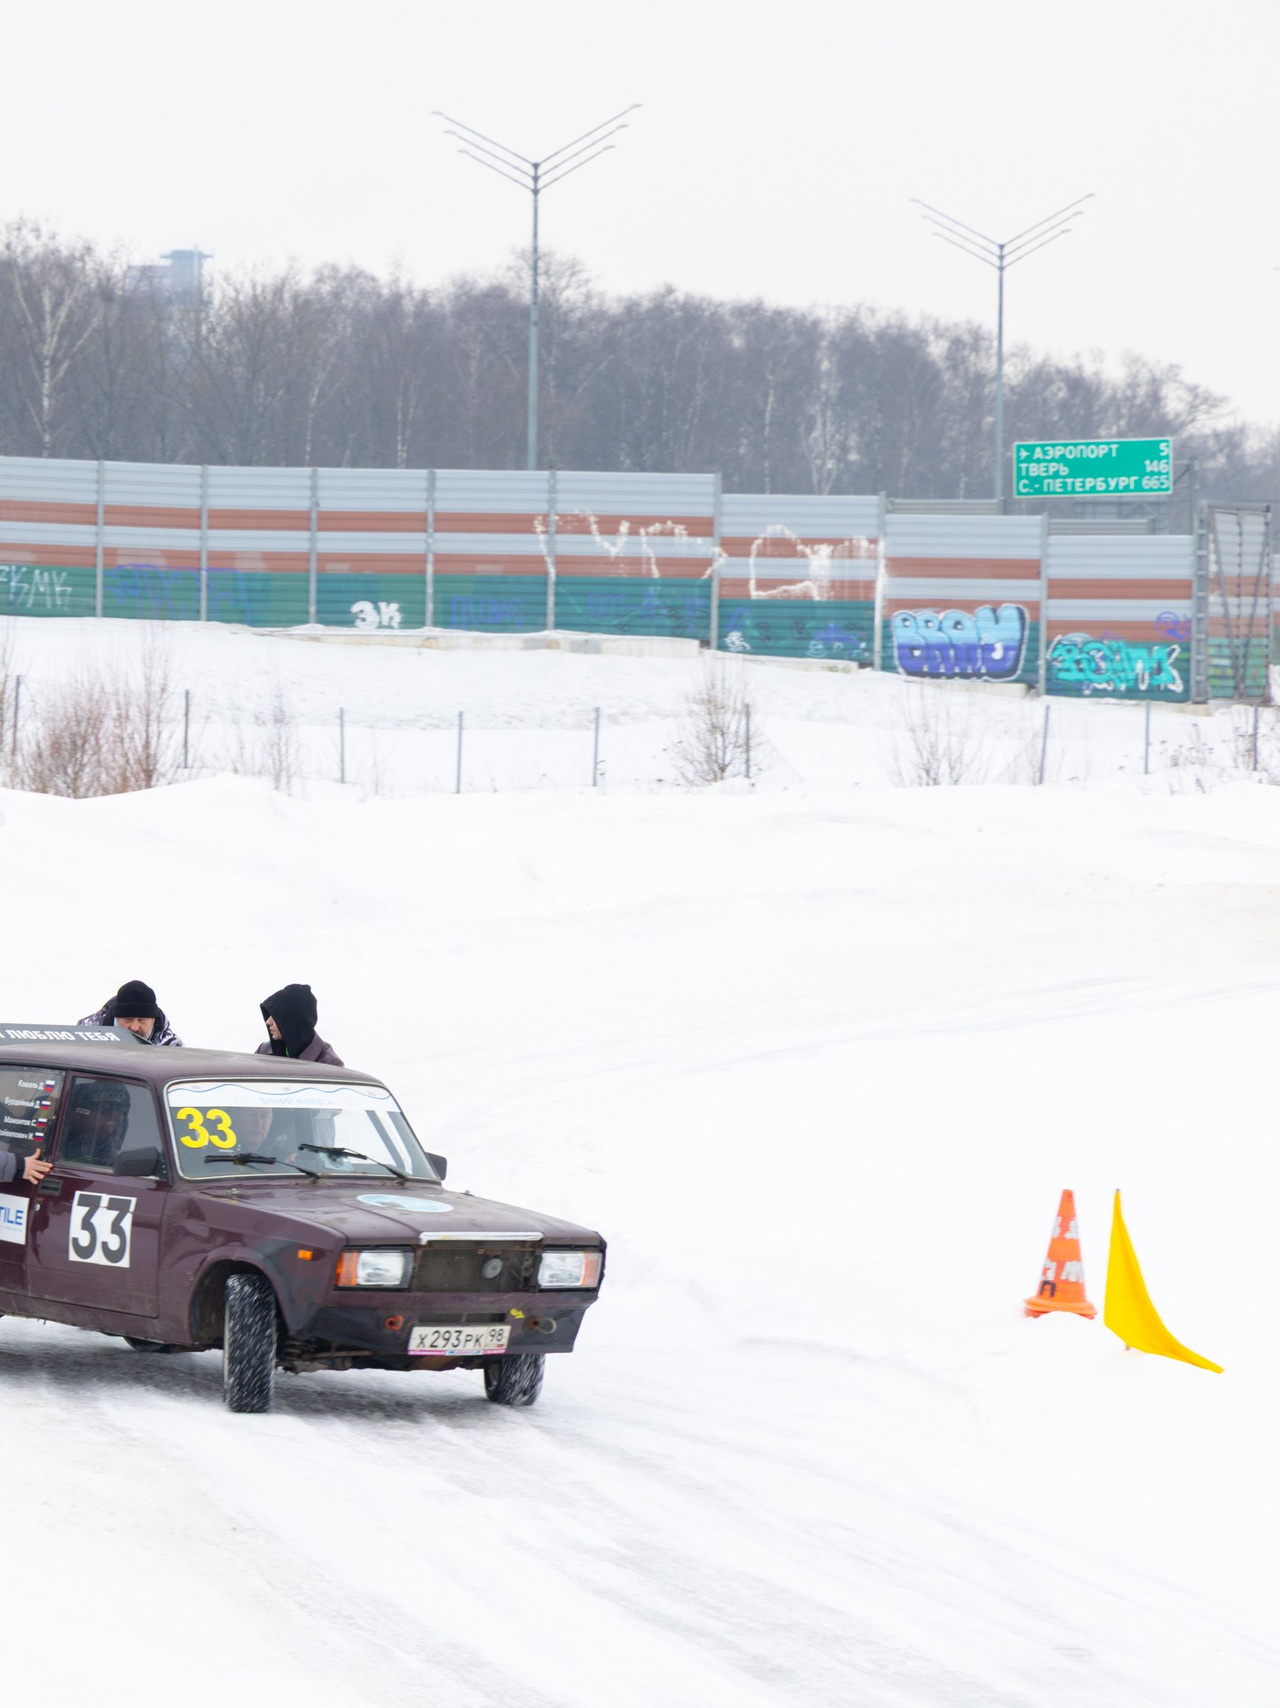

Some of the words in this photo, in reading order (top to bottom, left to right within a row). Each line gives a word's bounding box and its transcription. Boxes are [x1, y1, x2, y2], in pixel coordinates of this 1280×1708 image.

[1032, 444, 1119, 460] АЭРОПОРТ
[1159, 442, 1169, 456] 5
[1018, 462, 1070, 477] ТВЕРЬ
[1144, 459, 1169, 474] 146
[1141, 475, 1169, 489] 665
[5, 1029, 76, 1041] ЛЮБЛЮ
[75, 1031, 121, 1042] ТЕБЯ
[176, 1107, 237, 1149] 33
[71, 1193, 132, 1264] 33
[416, 1330, 484, 1349] Х293РК
[489, 1328, 505, 1342] 98
